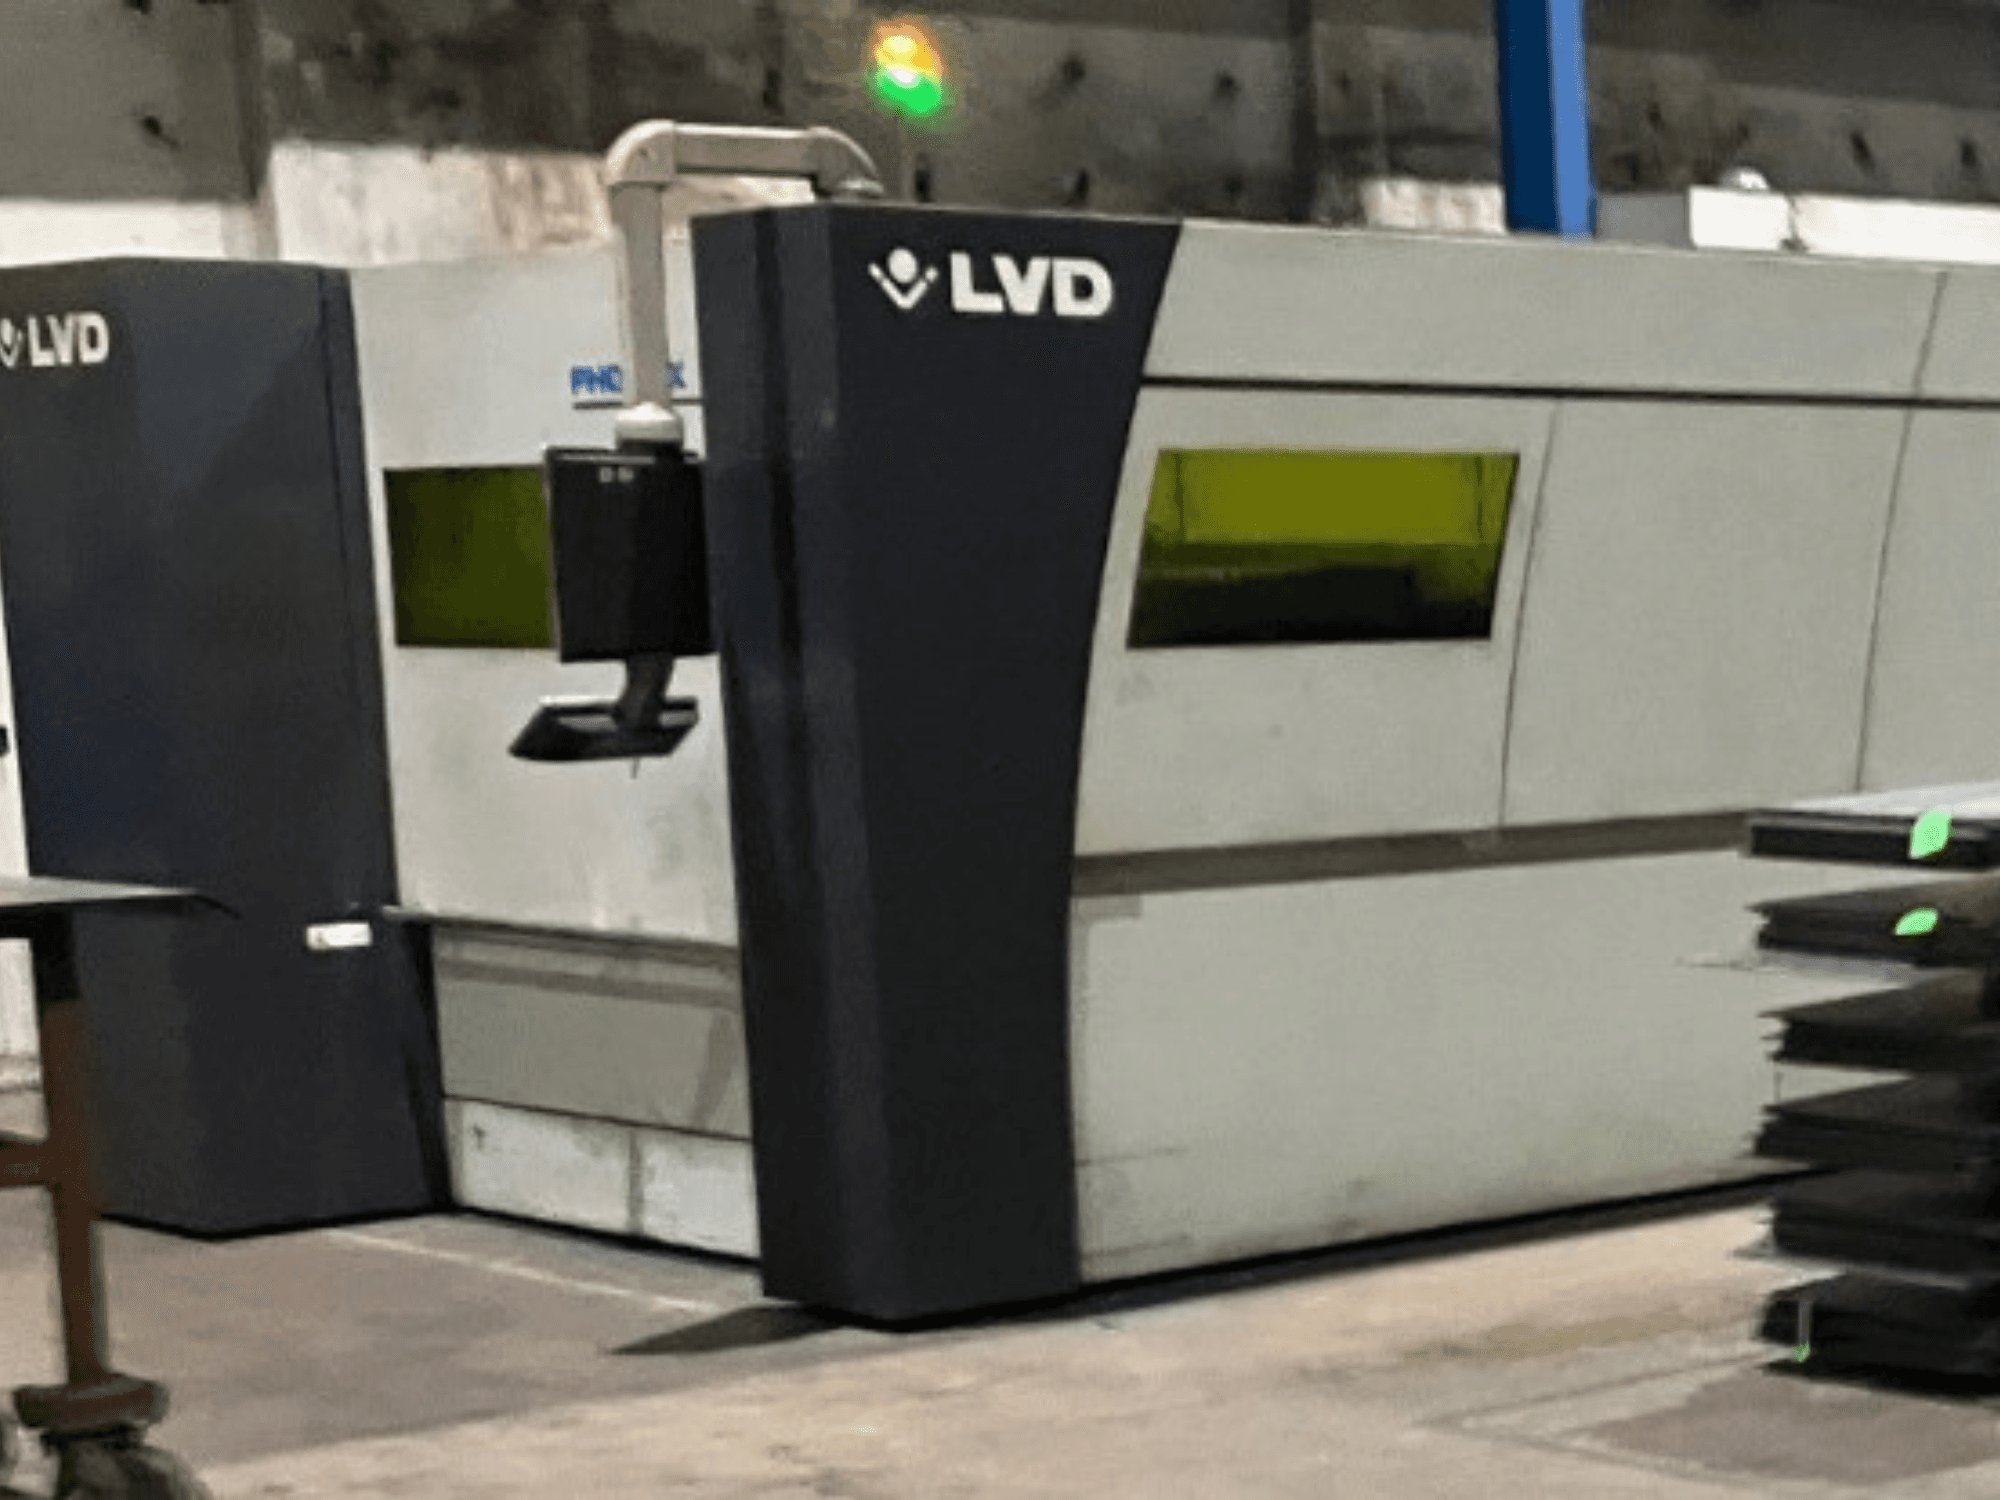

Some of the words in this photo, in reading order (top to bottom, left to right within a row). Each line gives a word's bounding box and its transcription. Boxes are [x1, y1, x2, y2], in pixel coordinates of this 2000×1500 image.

[950, 250, 1113, 316] LVD
[27, 311, 109, 367] LVD
[570, 362, 687, 394] PHOX
